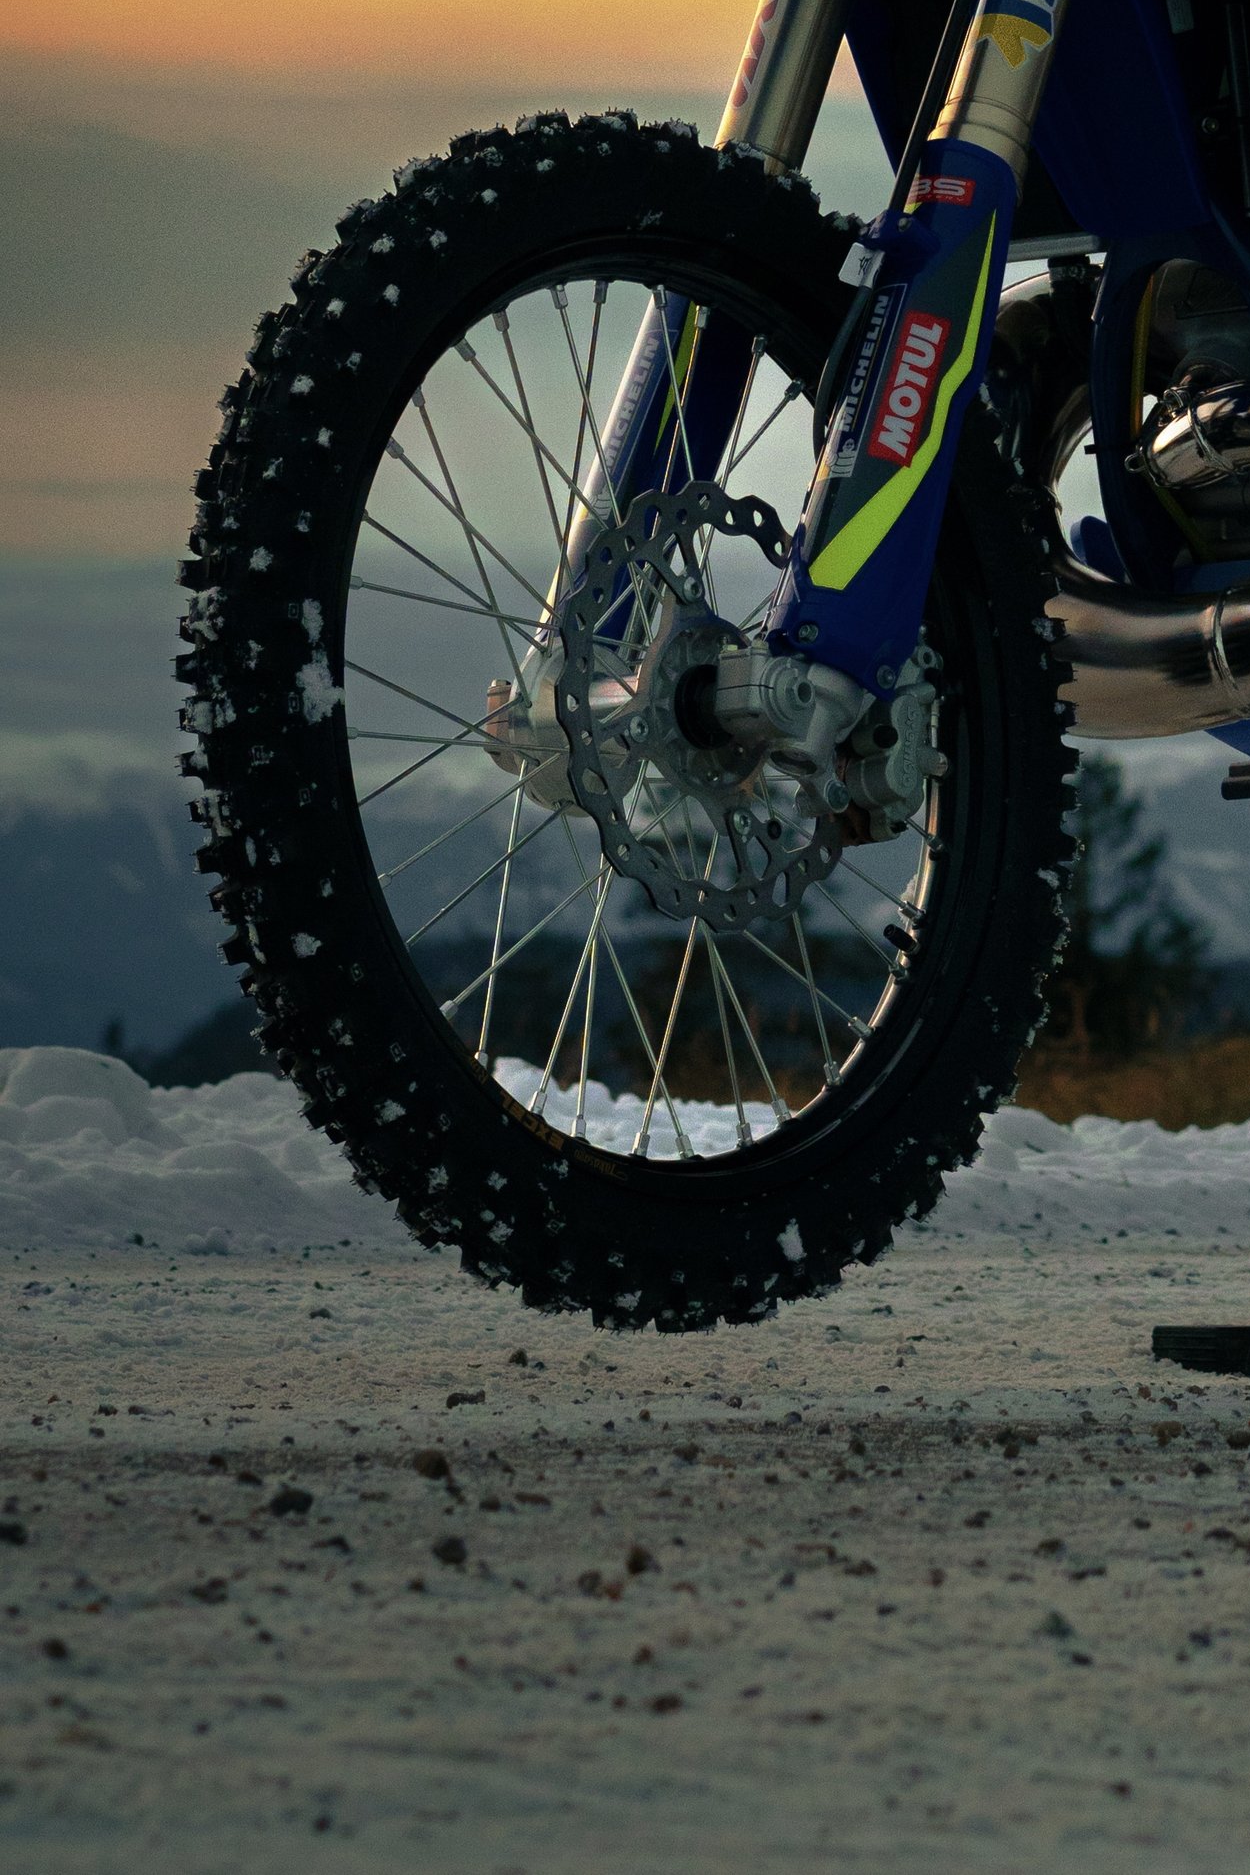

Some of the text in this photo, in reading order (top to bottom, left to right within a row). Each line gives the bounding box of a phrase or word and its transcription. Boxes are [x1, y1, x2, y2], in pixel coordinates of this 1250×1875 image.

[842, 294, 890, 432] MICHELIN
[878, 321, 942, 458] MOTUL
[500, 1093, 565, 1151] EXCEL
